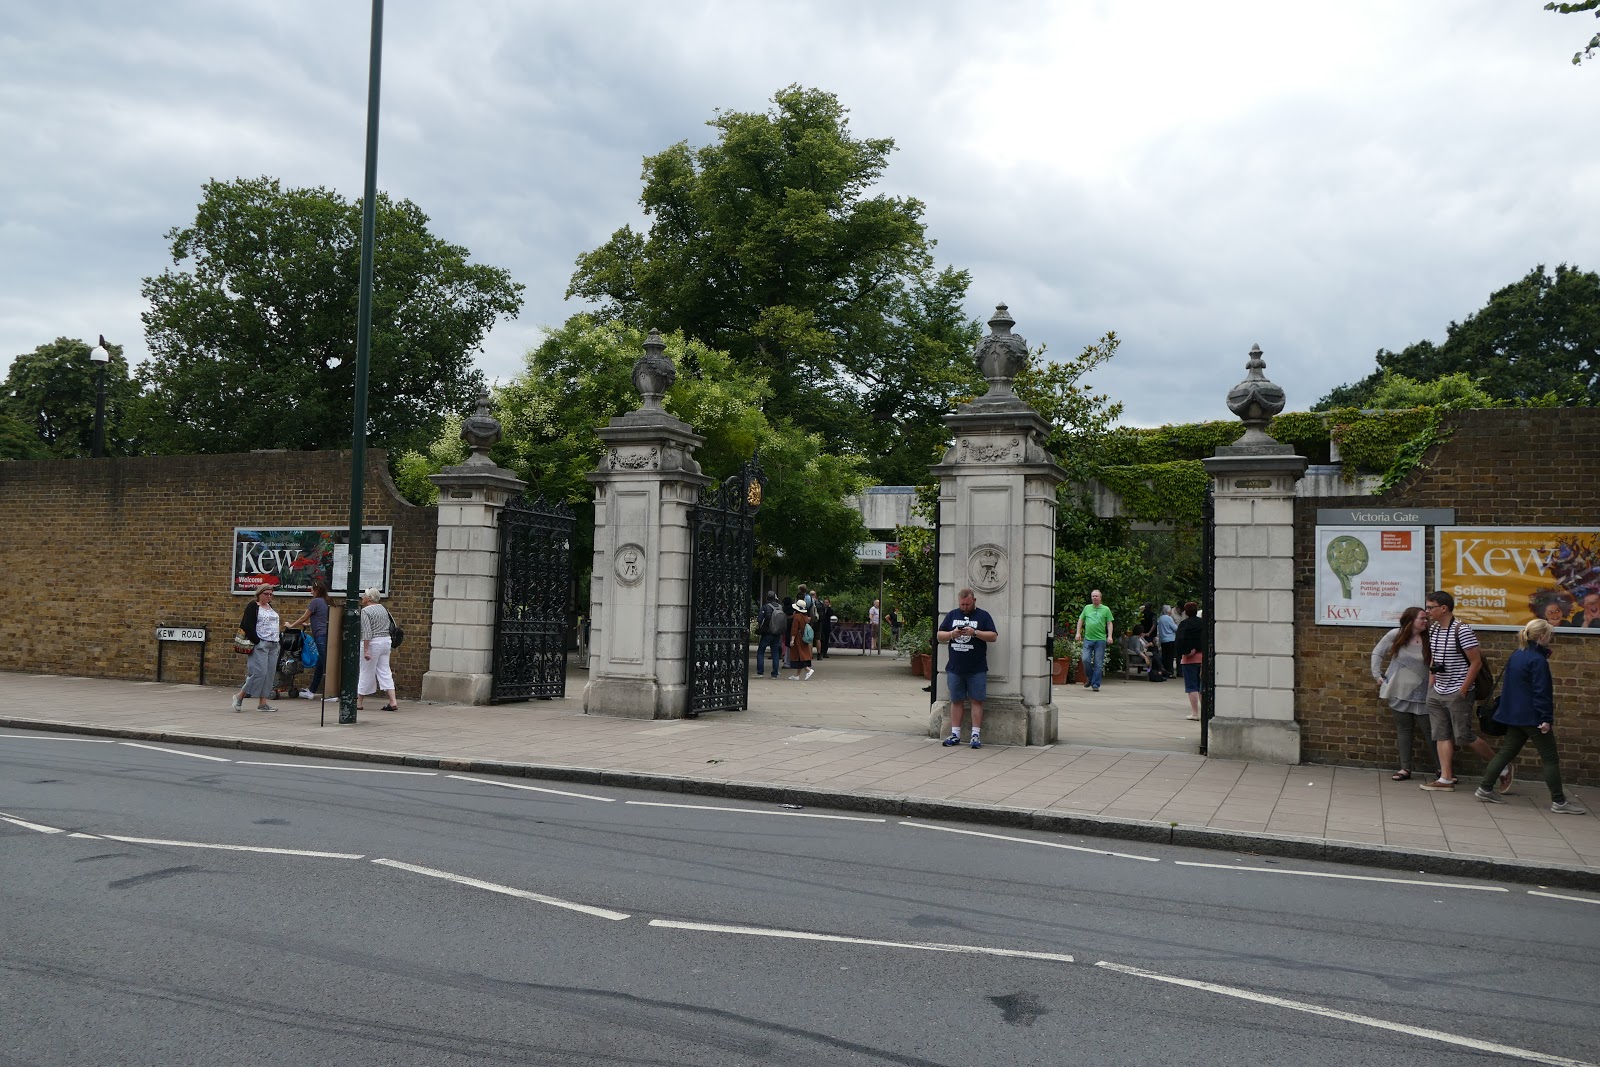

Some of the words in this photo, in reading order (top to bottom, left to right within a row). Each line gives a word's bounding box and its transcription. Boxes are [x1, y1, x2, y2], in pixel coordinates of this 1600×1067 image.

[1351, 511, 1390, 522] Victoria
[1393, 511, 1419, 522] Gate
[857, 546, 882, 556] dens
[239, 541, 302, 574] Kew
[1452, 539, 1560, 576] Kew
[980, 568, 999, 582] VR
[1454, 585, 1507, 596] Science
[1454, 596, 1506, 608] Festival
[1327, 604, 1361, 620] Kew
[157, 629, 175, 638] KEW
[181, 630, 204, 639] ROAD
